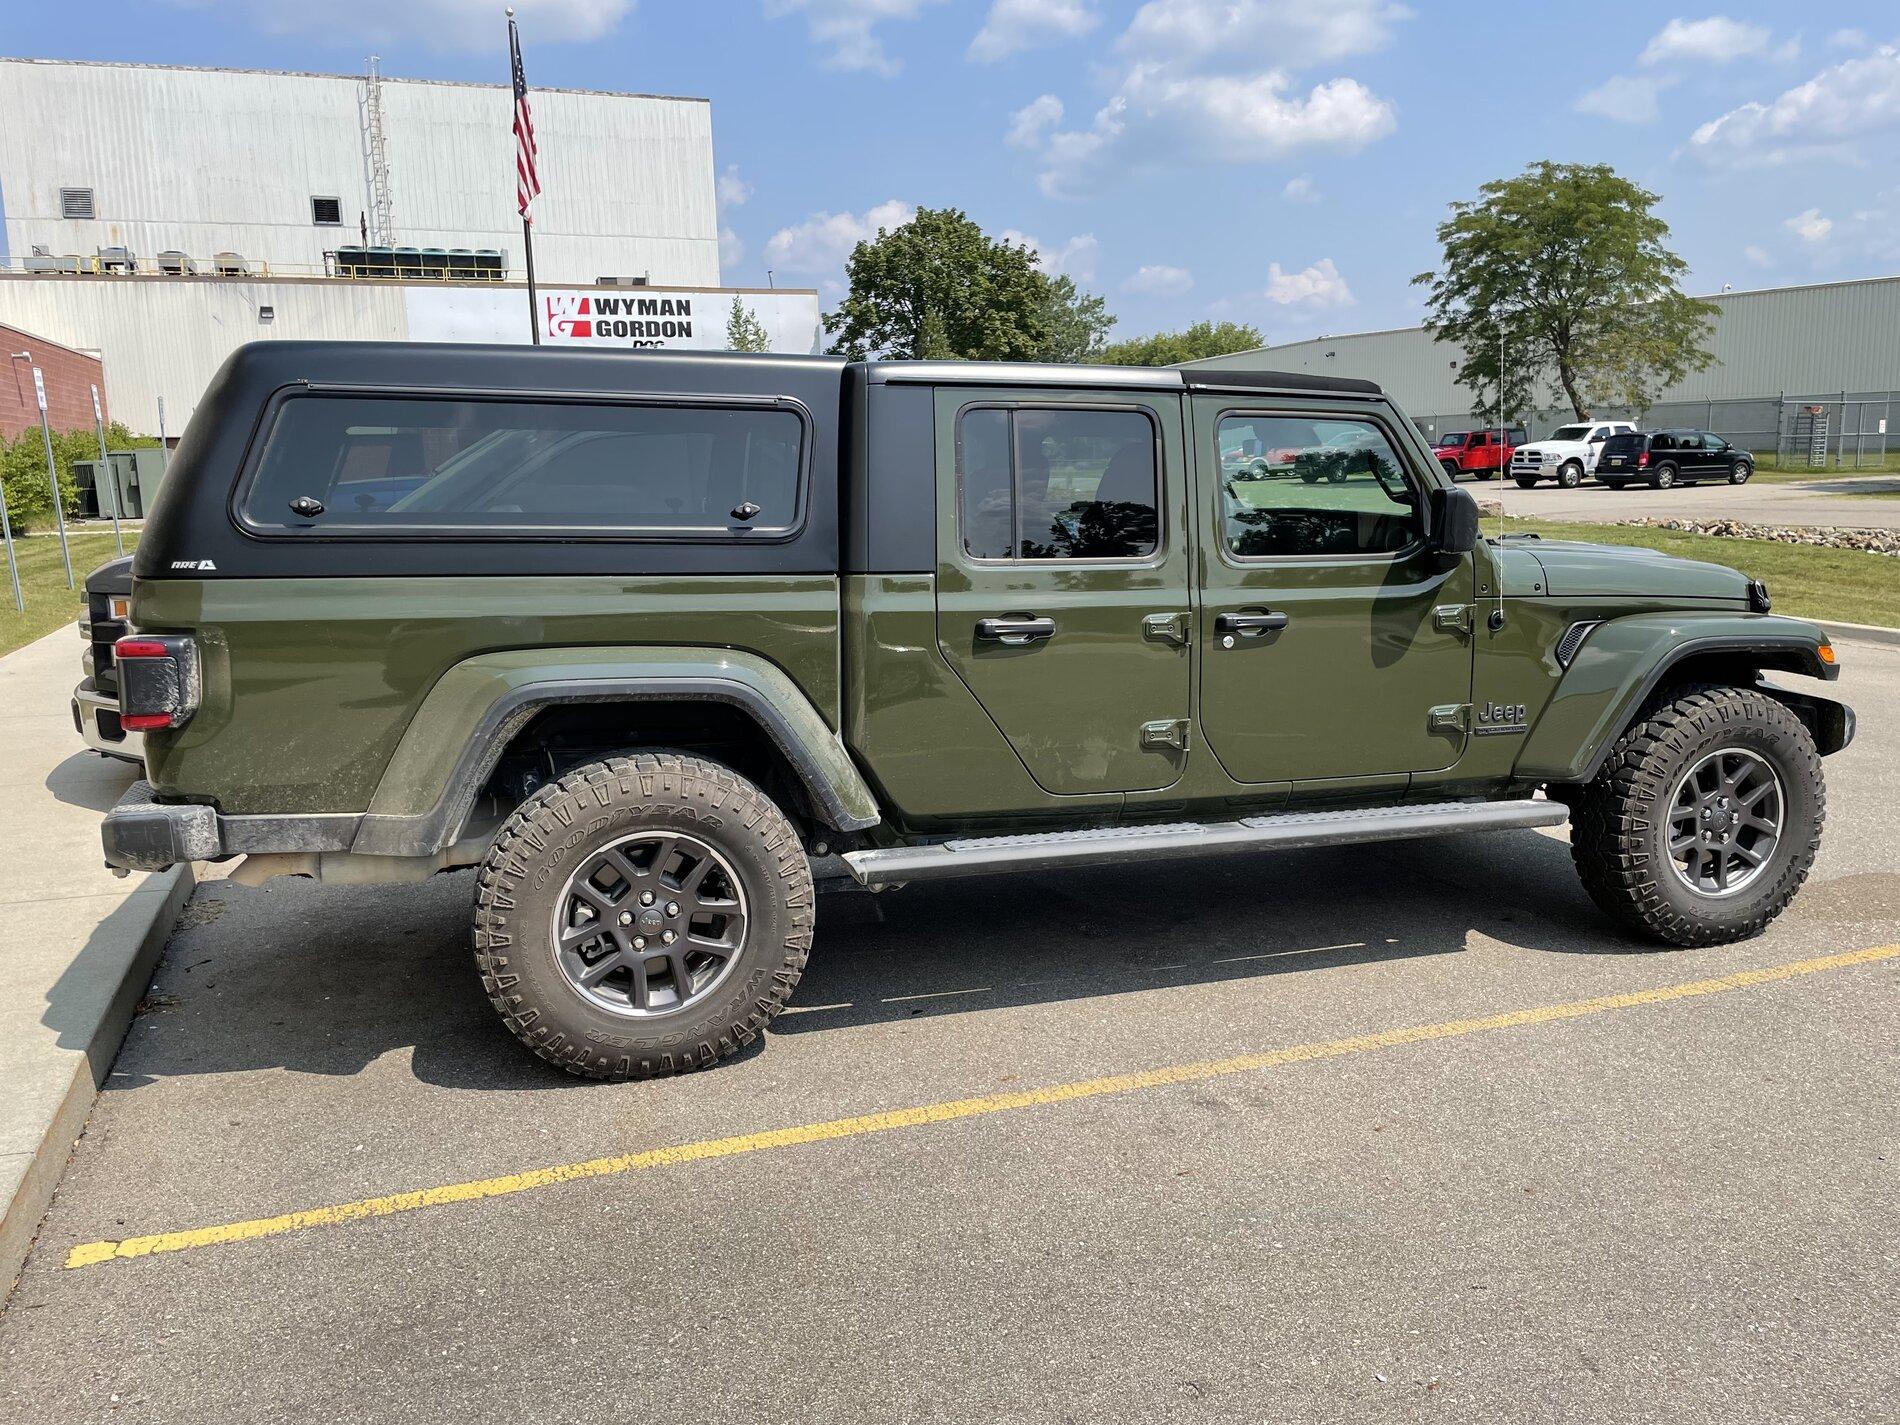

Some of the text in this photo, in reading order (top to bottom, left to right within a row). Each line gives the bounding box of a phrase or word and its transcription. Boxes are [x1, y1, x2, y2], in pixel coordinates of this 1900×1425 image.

[594, 298, 691, 316] WYMAN
[596, 320, 692, 338] GORDON
[1479, 702, 1526, 724] Jeep
[533, 803, 725, 891] GOODYEAR
[585, 967, 767, 1050] WRANGLER
